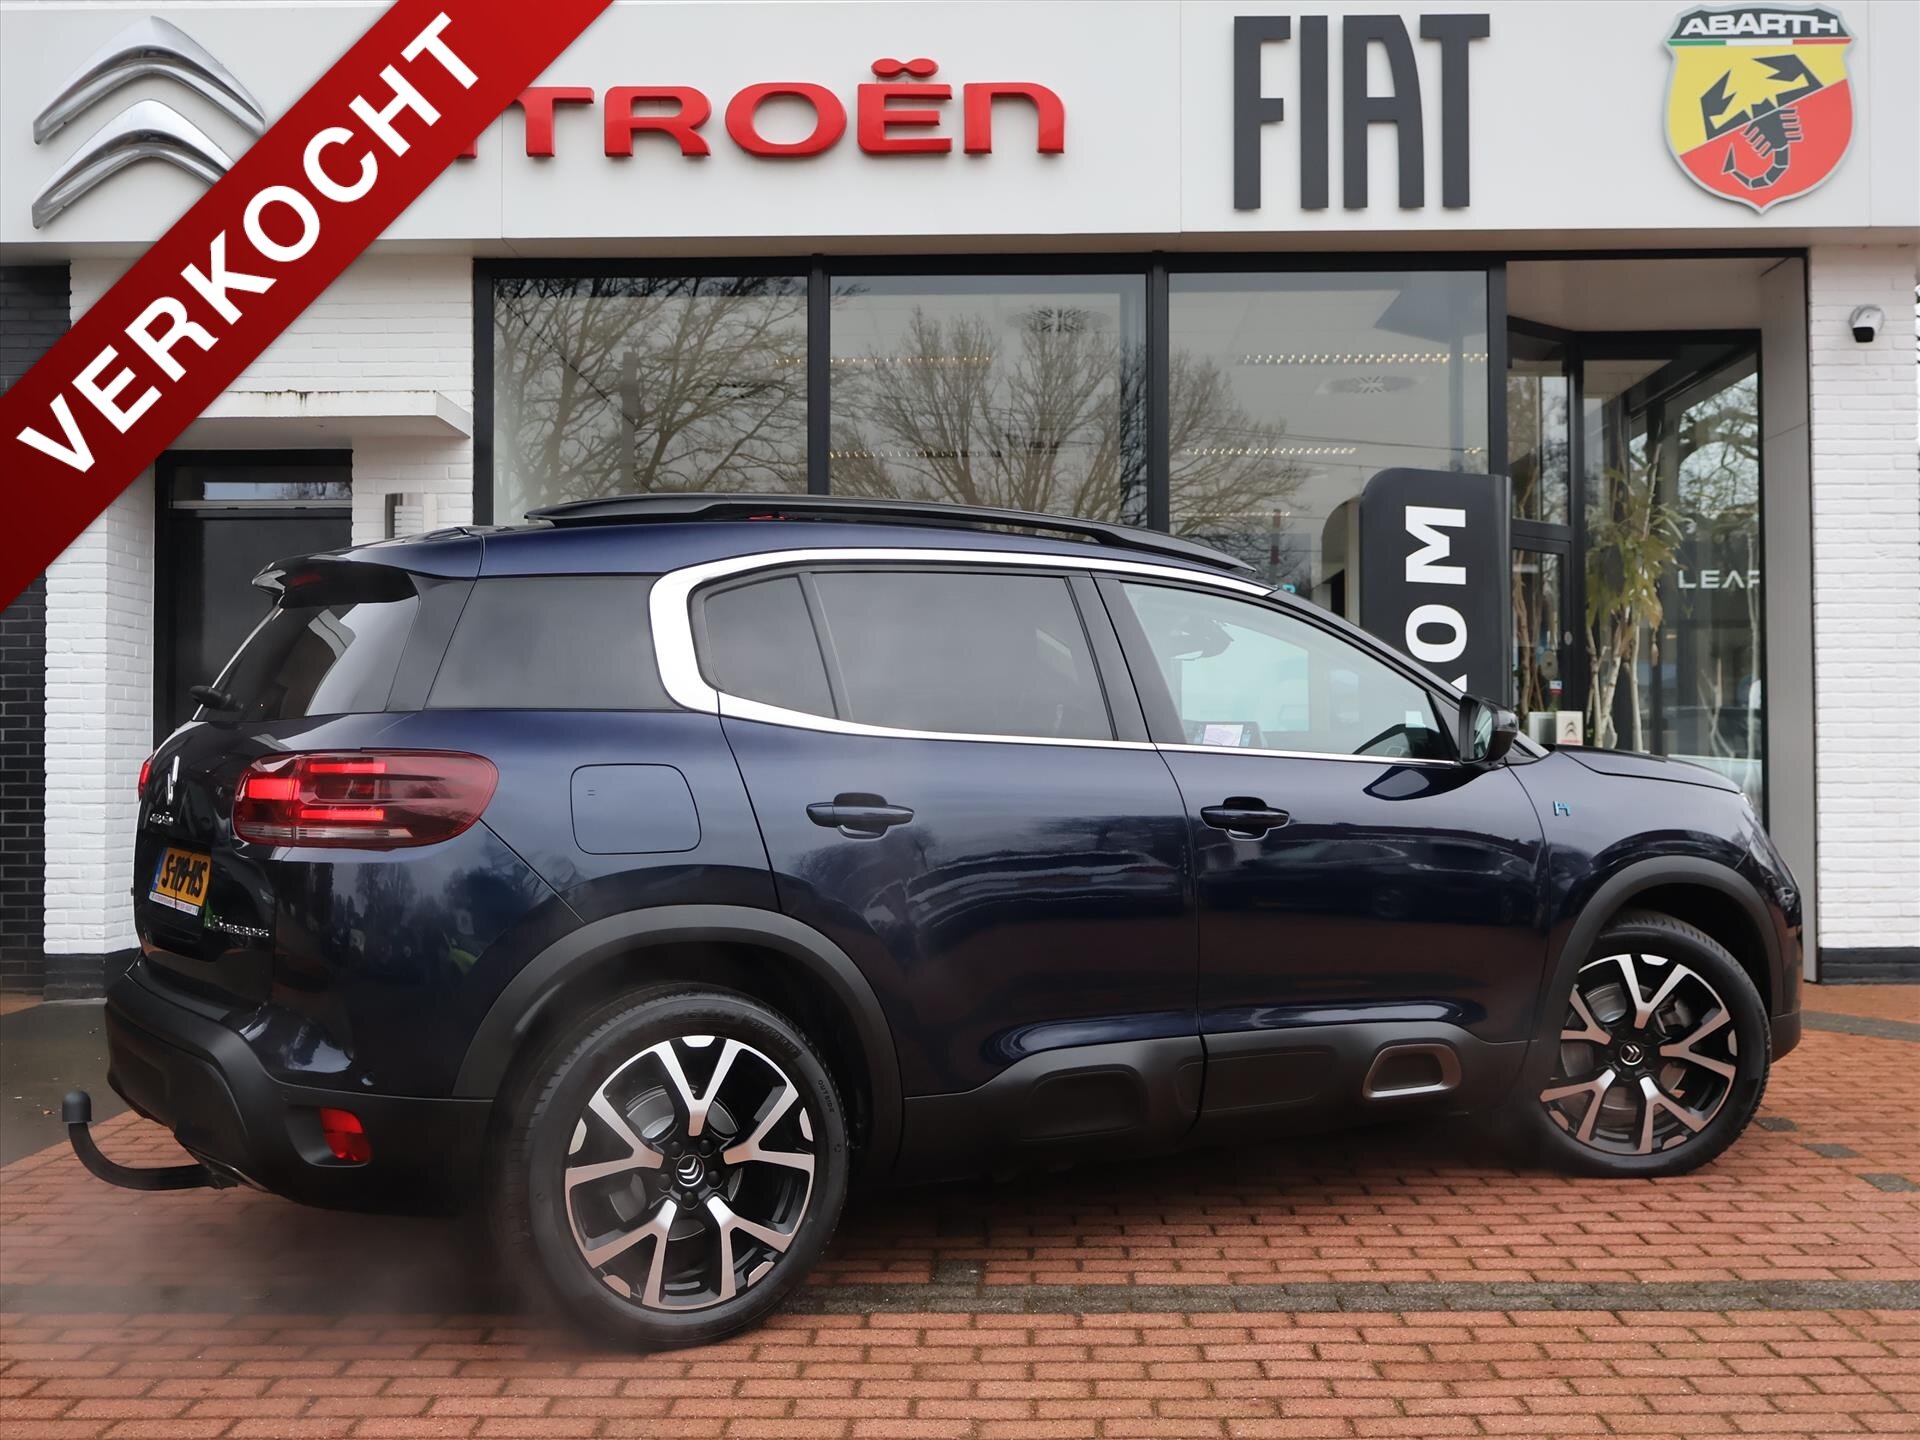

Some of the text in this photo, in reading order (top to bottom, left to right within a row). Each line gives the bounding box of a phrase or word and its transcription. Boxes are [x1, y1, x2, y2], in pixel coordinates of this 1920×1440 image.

[1679, 13, 1838, 36] ABARTH
[457, 58, 1065, 158] TROËN
[1233, 14, 1490, 210] FIAT
[1405, 505, 1467, 693] OM
